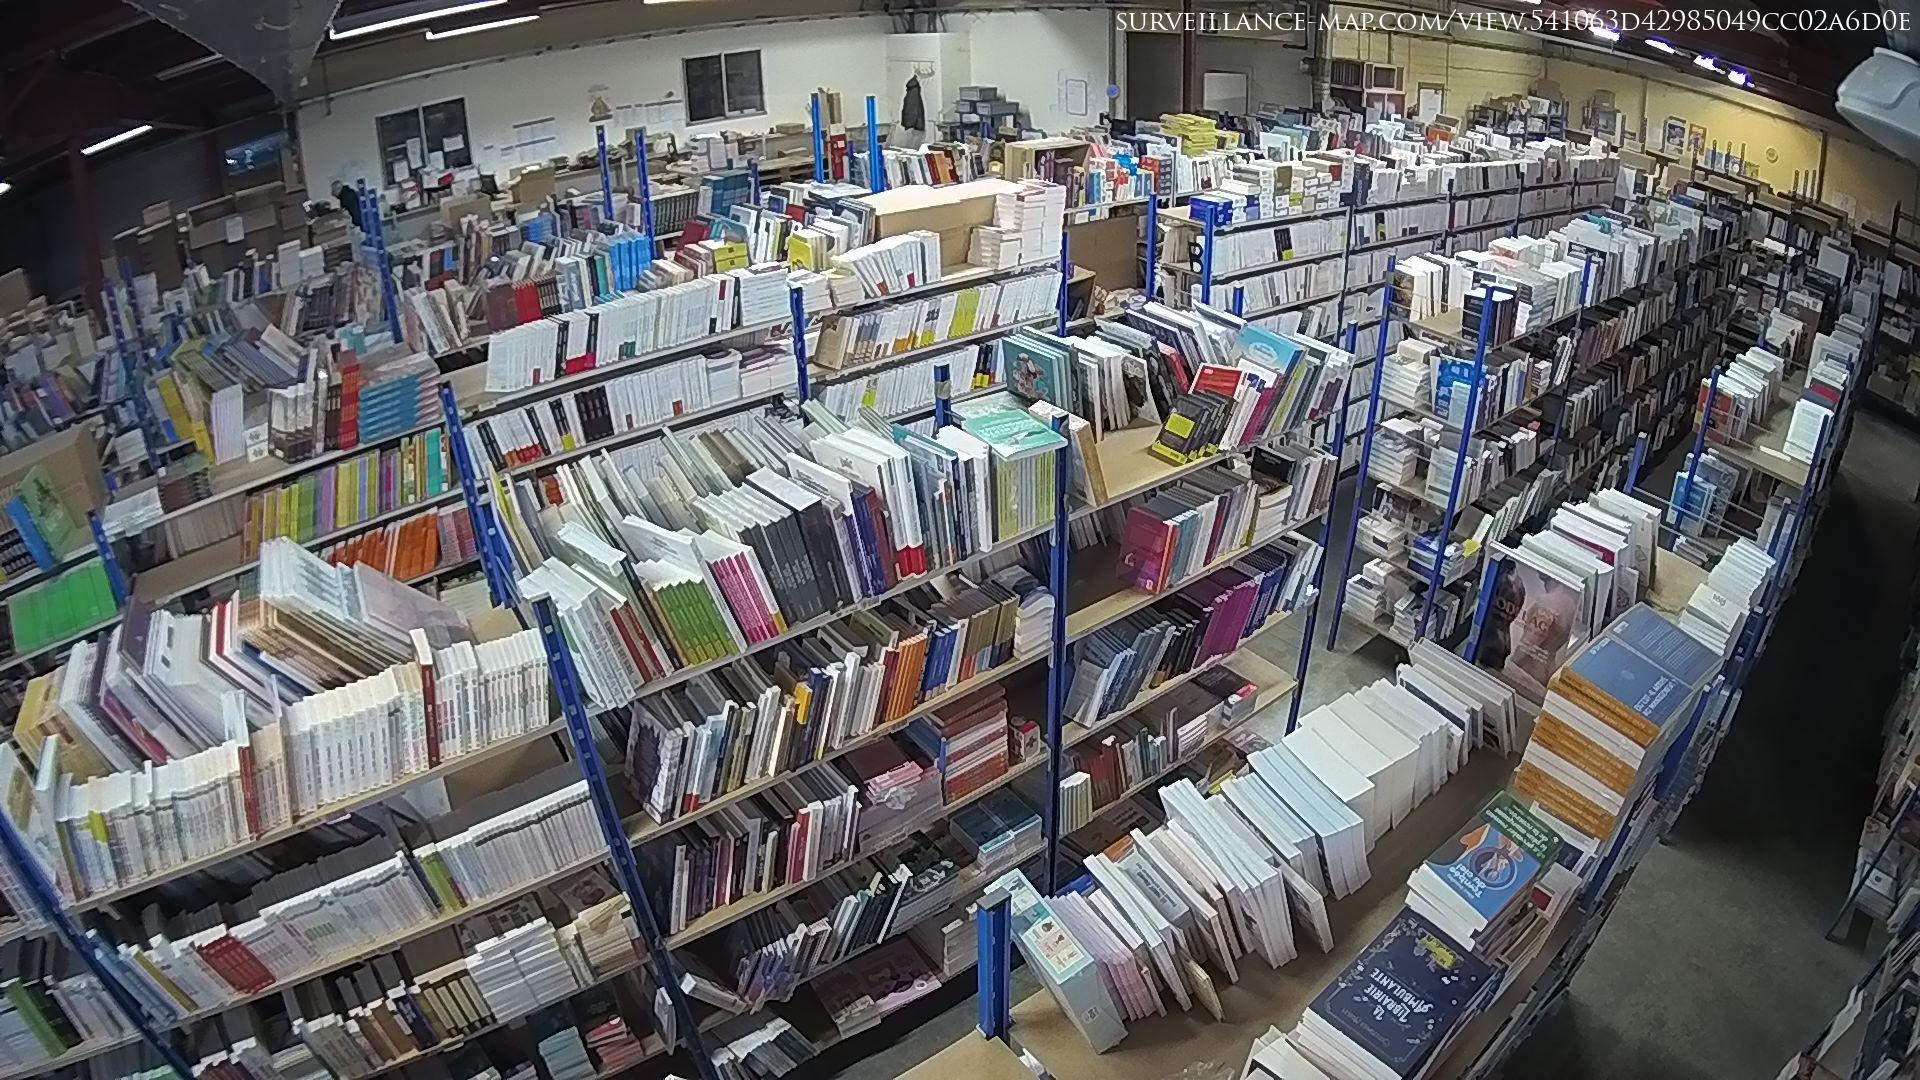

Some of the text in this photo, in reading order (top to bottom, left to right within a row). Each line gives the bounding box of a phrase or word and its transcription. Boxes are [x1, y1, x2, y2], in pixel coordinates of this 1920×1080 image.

[1456, 864, 1486, 888] du ciel
[1364, 984, 1410, 1022] LIBRAIRIE
[1370, 968, 1434, 1012] AMBULANTE
[1373, 1004, 1384, 1021] LA
